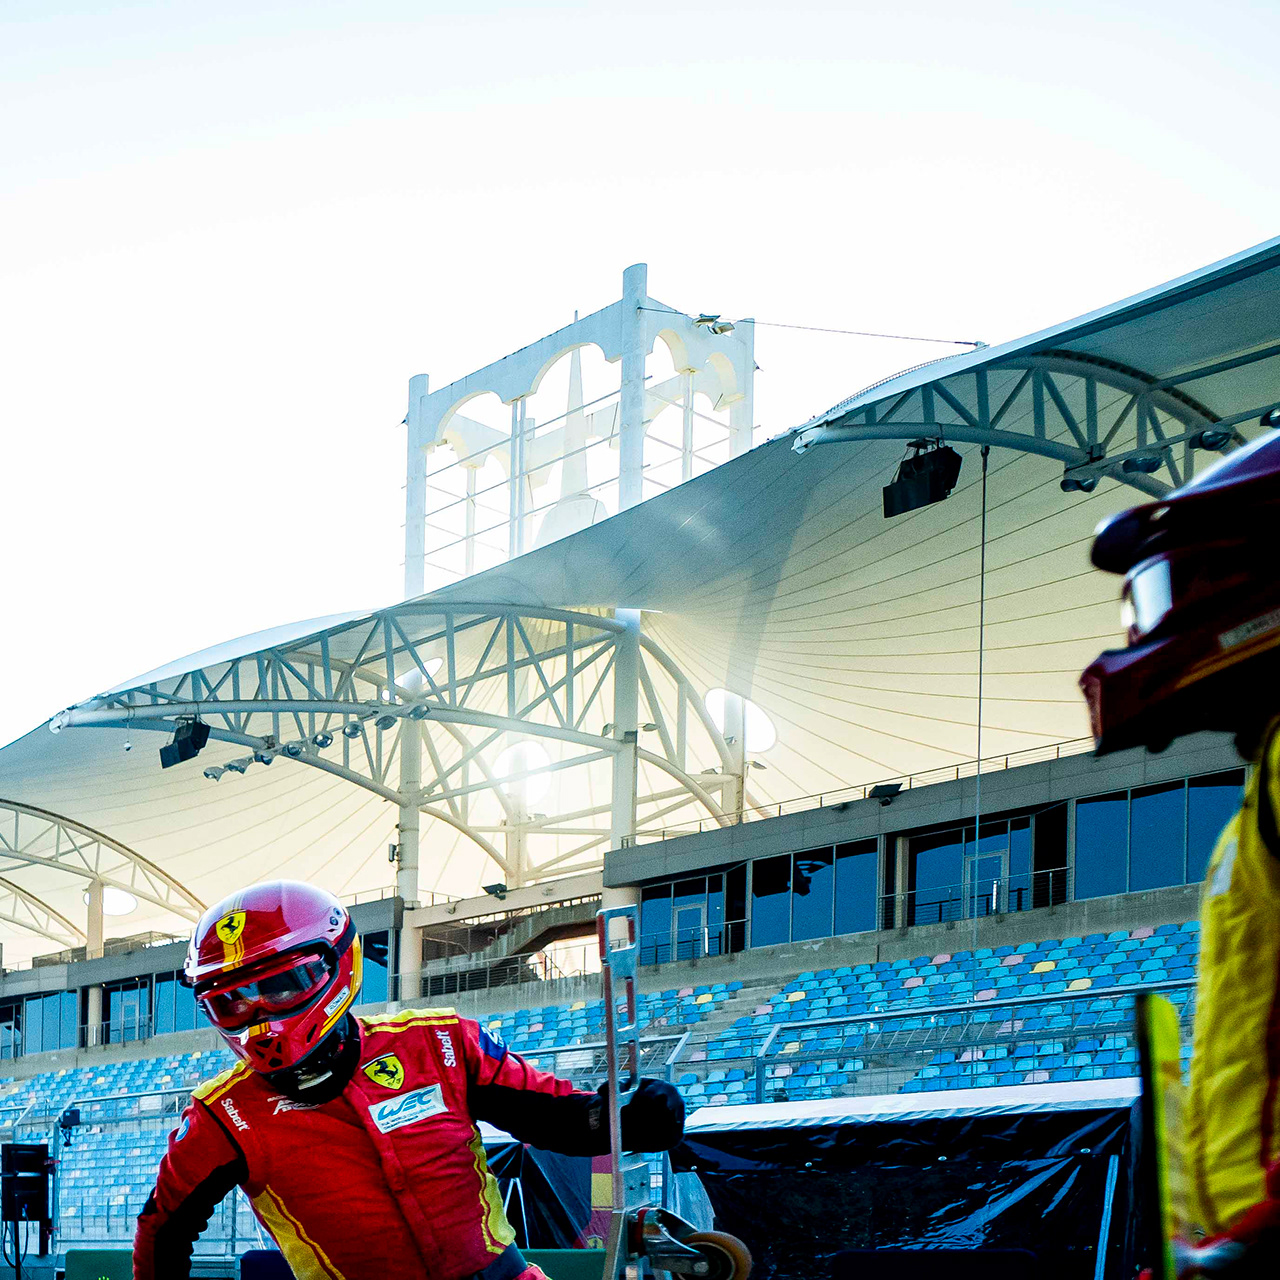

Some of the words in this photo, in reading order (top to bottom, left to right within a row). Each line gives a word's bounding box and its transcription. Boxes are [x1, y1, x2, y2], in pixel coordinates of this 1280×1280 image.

[435, 1029, 457, 1068] Sabelt
[221, 1098, 250, 1132] Sabelt
[377, 1087, 436, 1121] WEC
